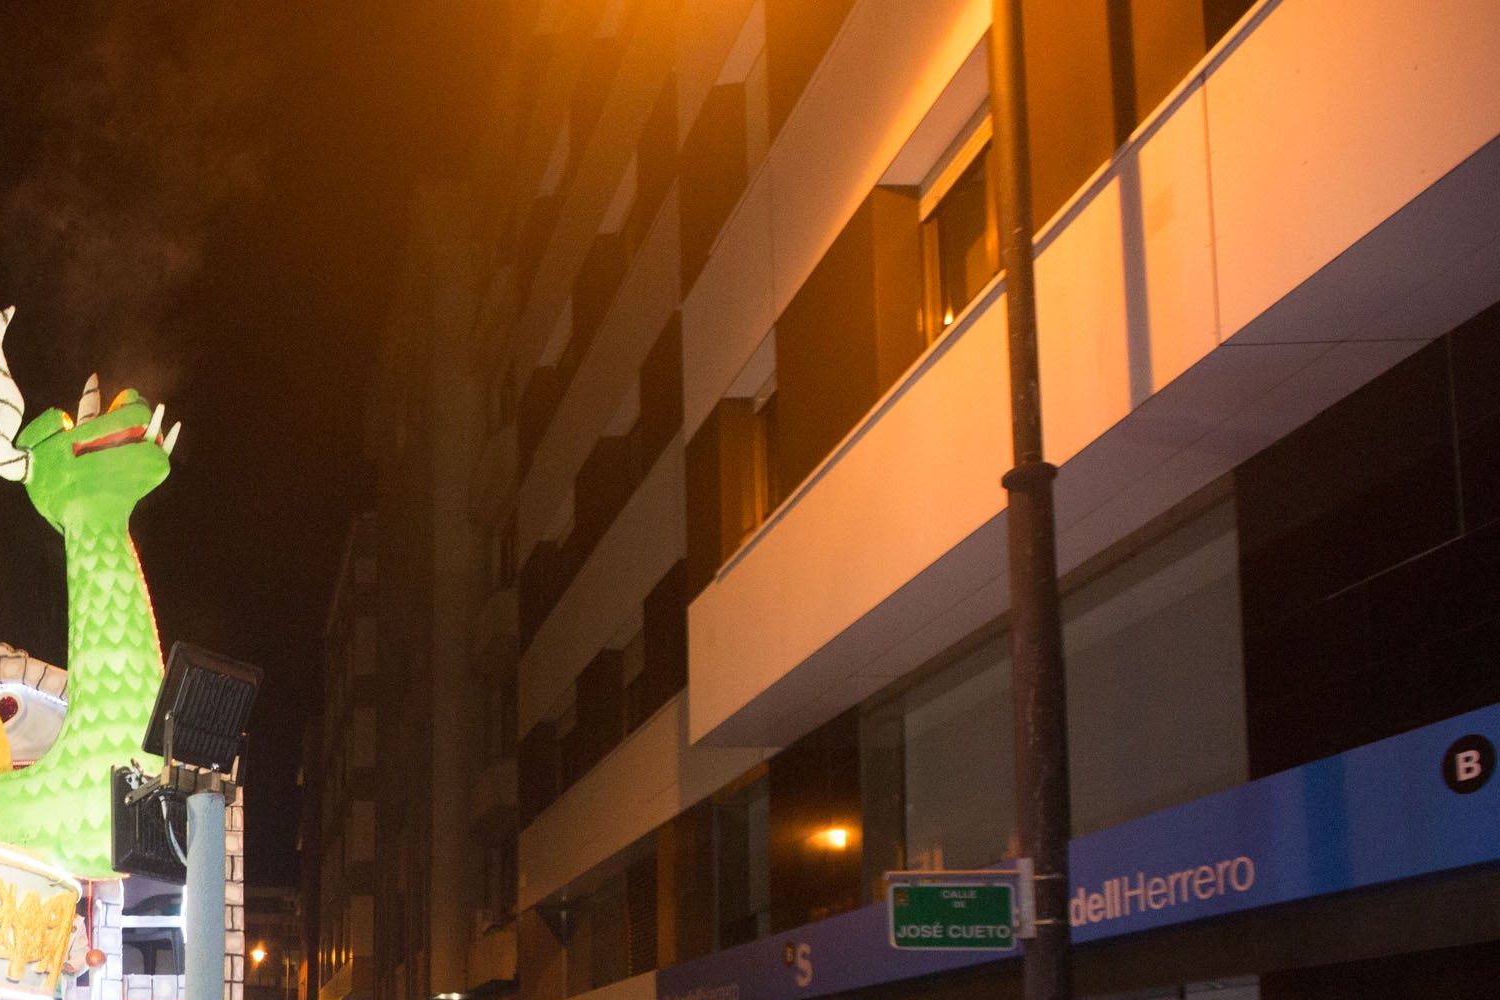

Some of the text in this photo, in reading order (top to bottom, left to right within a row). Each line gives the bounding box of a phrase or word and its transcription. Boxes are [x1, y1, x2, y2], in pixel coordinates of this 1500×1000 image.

[1454, 749, 1483, 782] B
[942, 889, 978, 899] CALLE
[896, 921, 1012, 938] JOSÉ CUETO
